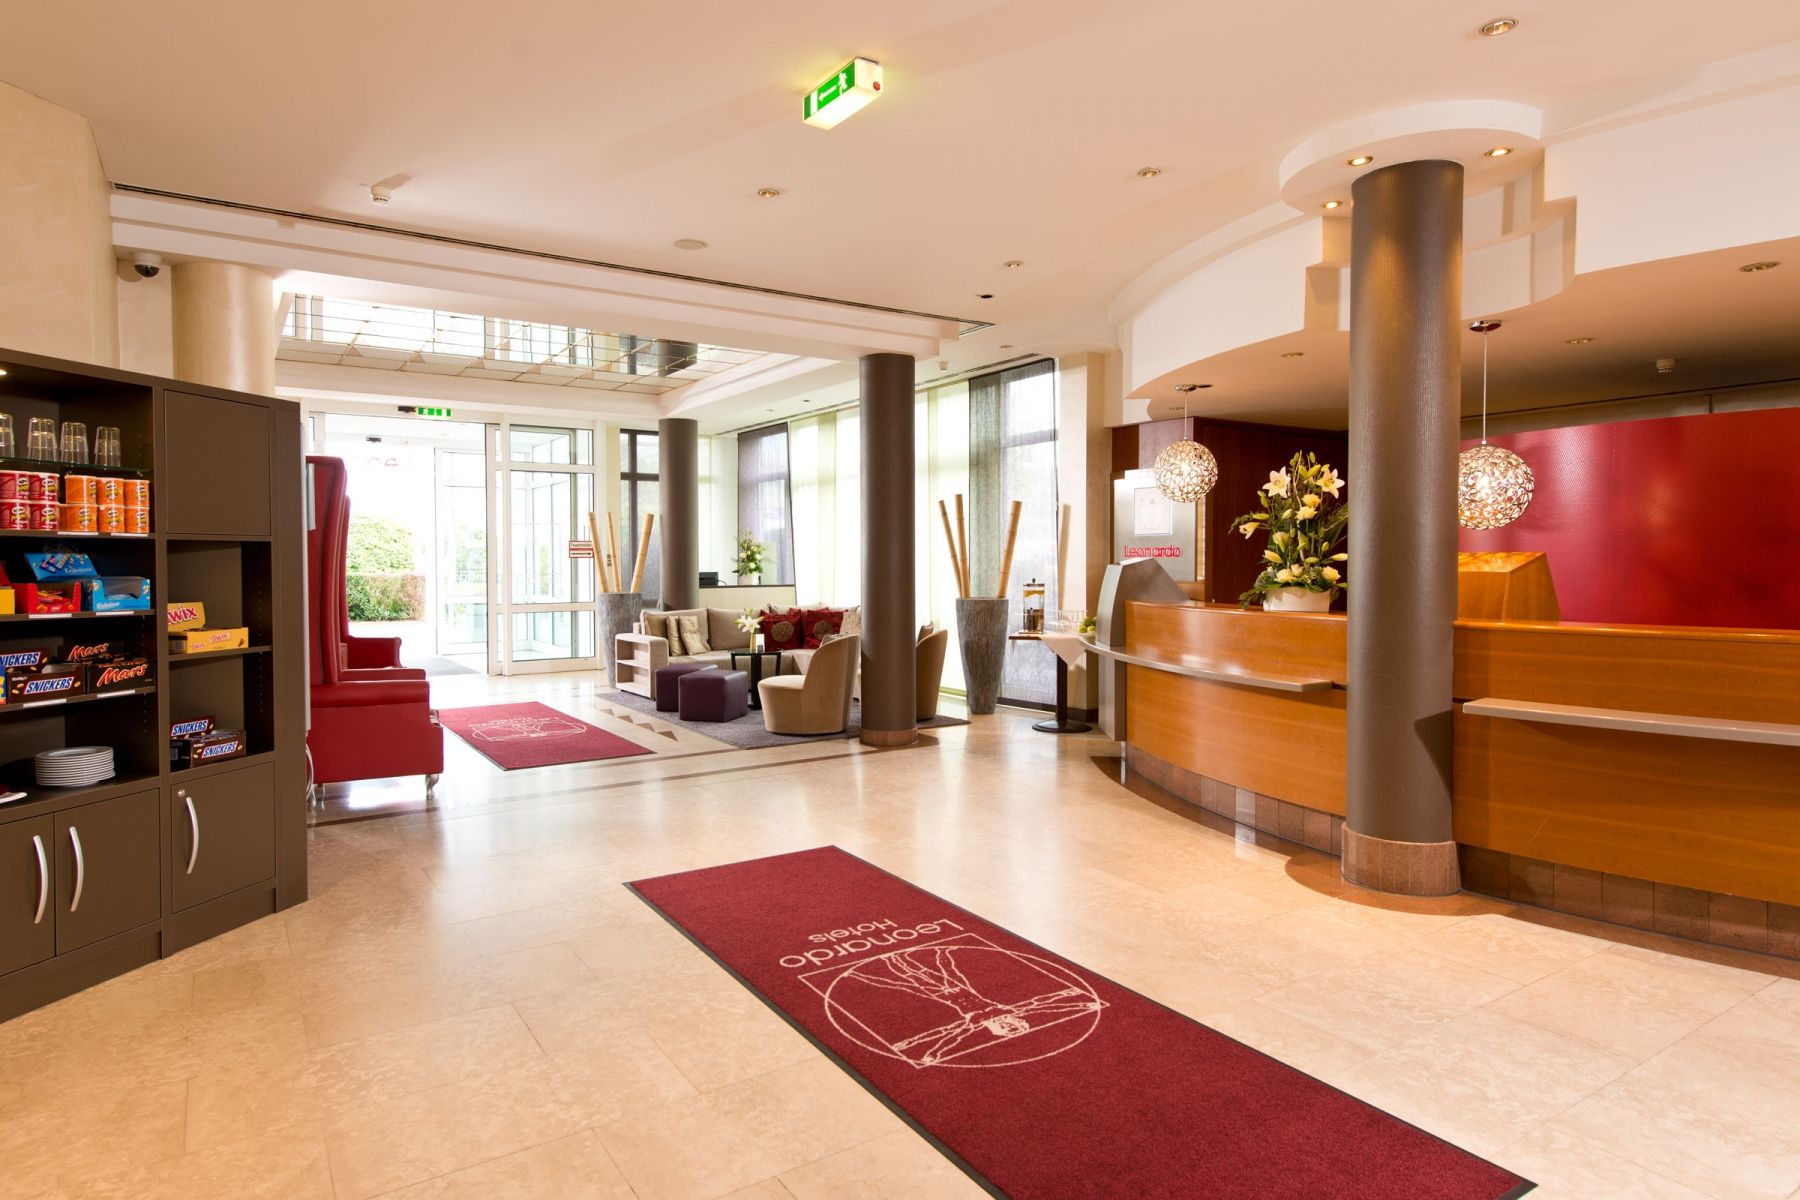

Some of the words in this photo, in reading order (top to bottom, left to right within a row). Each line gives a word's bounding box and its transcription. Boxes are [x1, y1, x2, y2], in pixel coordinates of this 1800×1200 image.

[1124, 545, 1182, 558] Leonardo
[68, 643, 109, 660] Mars
[0, 653, 39, 666] NICKERS
[97, 664, 147, 687] Mars
[26, 679, 73, 693] SNICKERS
[172, 721, 207, 735] SNICKERS
[204, 742, 236, 757] SNICKERS
[808, 918, 898, 943] Hotels
[779, 918, 964, 968] Leonardo
